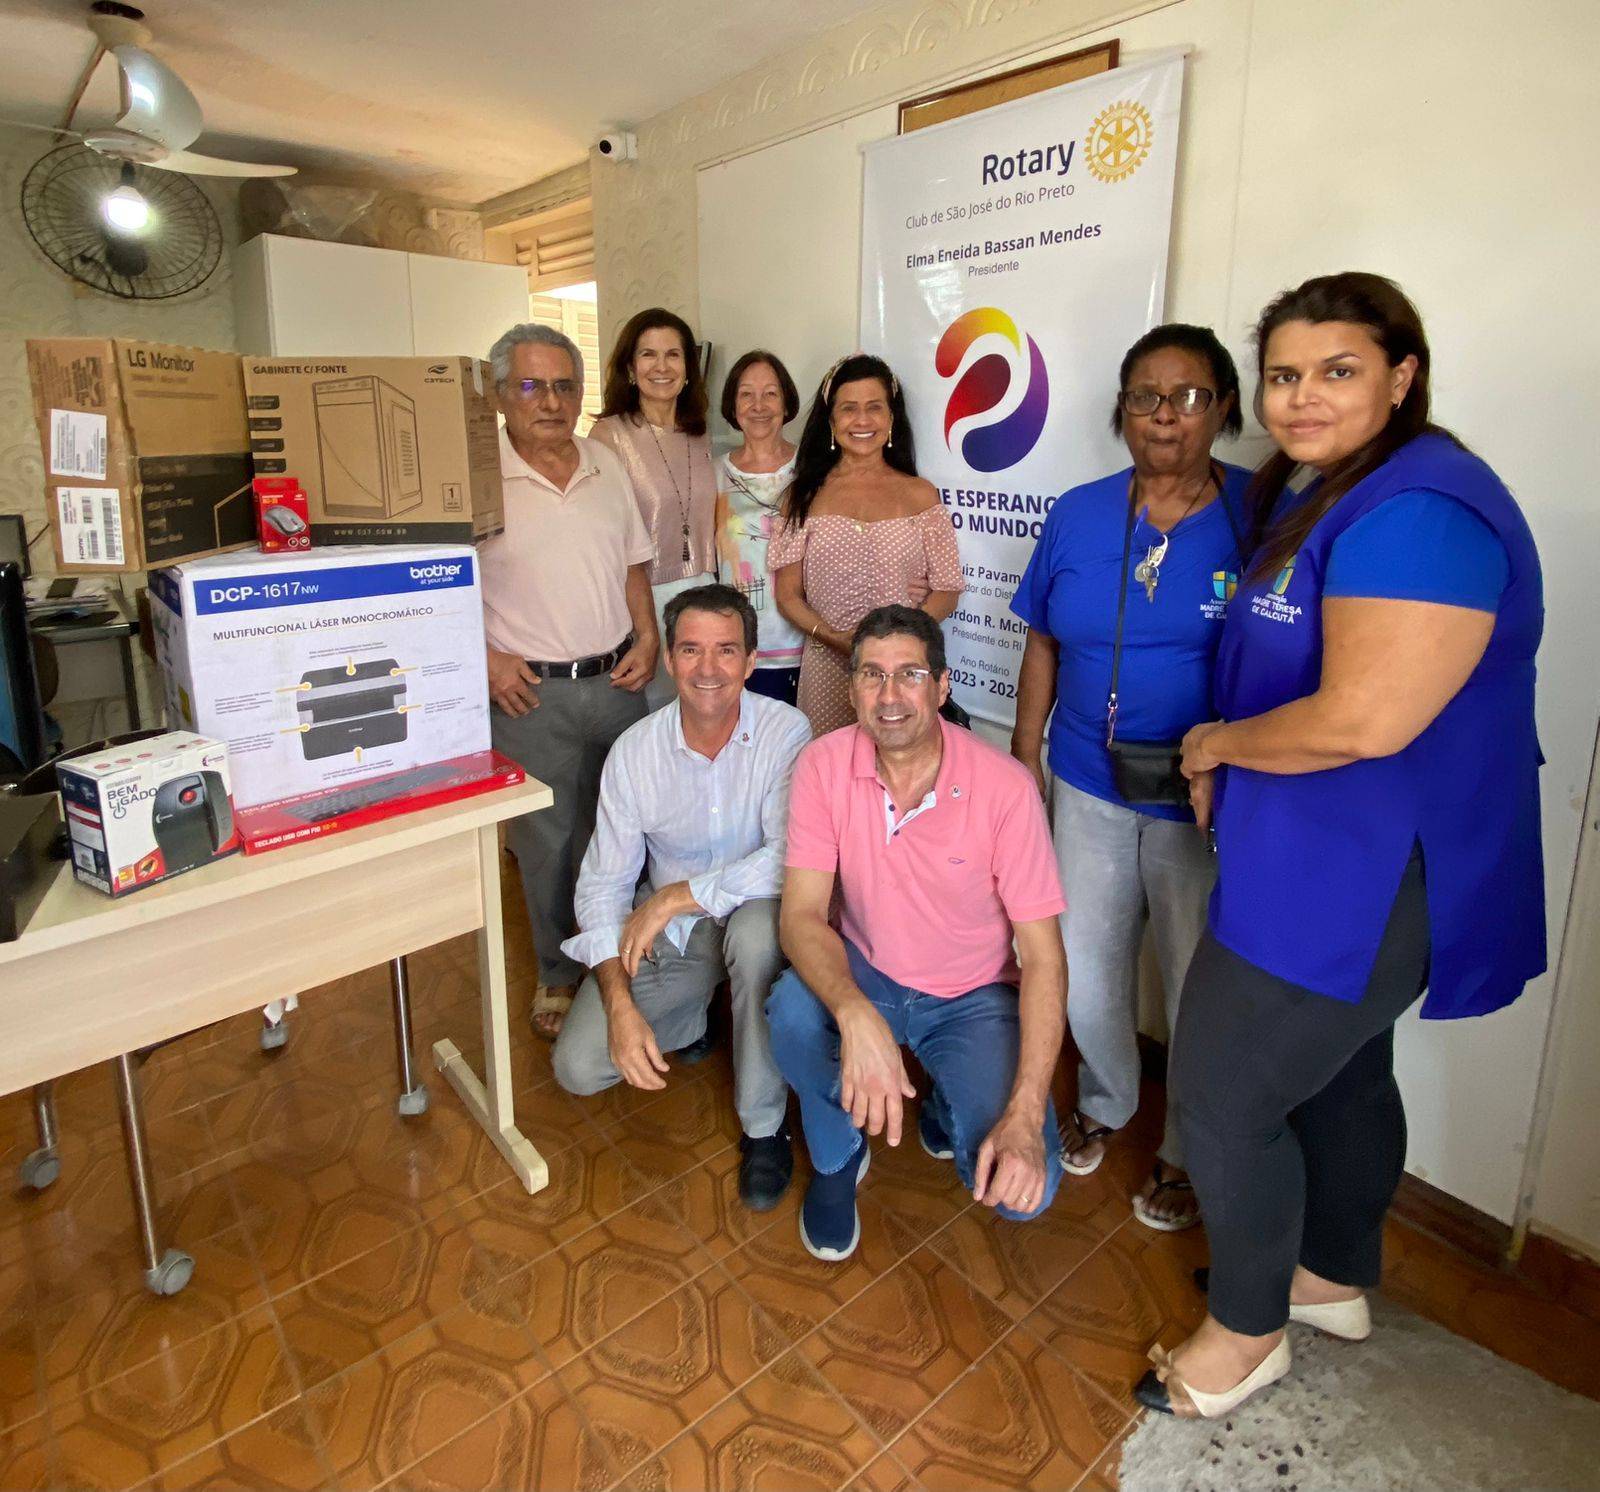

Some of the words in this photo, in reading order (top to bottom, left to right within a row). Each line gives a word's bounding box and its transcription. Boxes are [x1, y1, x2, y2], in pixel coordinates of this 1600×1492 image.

[982, 140, 1075, 185] Rotary
[905, 213, 928, 230] Club
[930, 210, 944, 224] de
[946, 206, 966, 221] São
[967, 198, 992, 219] José
[995, 194, 1012, 210] do
[1014, 190, 1035, 207] Rio
[1038, 184, 1075, 201] Preto
[906, 253, 935, 269] Elma
[938, 243, 980, 263] Eneida
[984, 236, 1035, 255] Bassan
[1039, 223, 1102, 246] Mendes
[968, 260, 1020, 277] Presidente
[127, 348, 146, 368] LG
[150, 351, 195, 372] Monitor
[253, 365, 302, 375] GABINETE
[303, 365, 314, 374] C/
[315, 365, 348, 374] FONTE
[448, 487, 454, 498] 1
[951, 512, 963, 529] O
[968, 514, 1045, 540] MUNDO
[410, 564, 463, 579] brother
[427, 577, 441, 586] your
[441, 575, 454, 583] side
[978, 566, 1021, 585] Pavam
[210, 582, 320, 604] DCP-1617NW
[964, 583, 979, 593] dor
[981, 585, 992, 596] do
[1251, 604, 1260, 613] DE
[1271, 601, 1302, 615] TERESA
[213, 622, 307, 641] MULTIFUNCIONAL
[310, 618, 339, 630] LÁSER
[341, 606, 433, 625] MONOCROMÁTICO
[948, 609, 980, 625] ordon
[984, 614, 995, 629] R.
[999, 618, 1031, 635] McIn
[952, 626, 995, 646] Presidente
[997, 638, 1009, 649] do
[1012, 640, 1022, 651] RI
[960, 655, 977, 668] Ano
[978, 659, 1010, 677] Rotário
[948, 667, 976, 687] 2023
[989, 679, 1018, 699] 202
[107, 784, 138, 800] BEM
